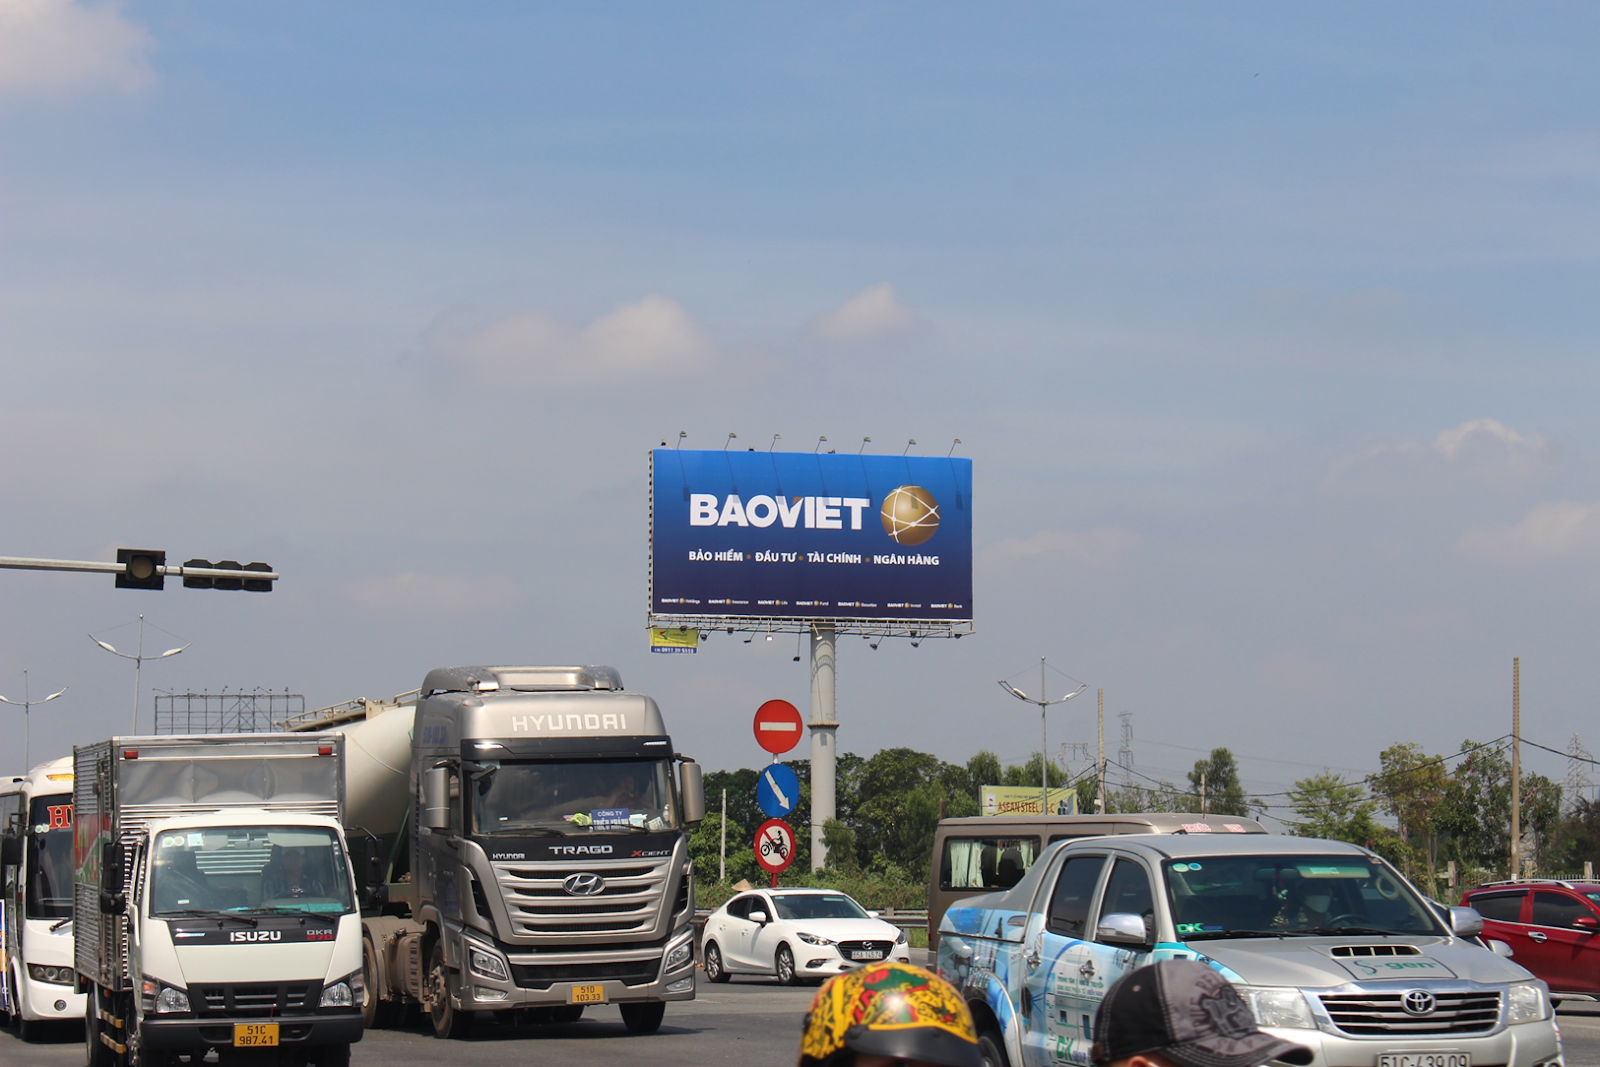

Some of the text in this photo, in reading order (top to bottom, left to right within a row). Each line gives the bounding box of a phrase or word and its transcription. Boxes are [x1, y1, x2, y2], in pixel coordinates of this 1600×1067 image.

[690, 494, 870, 530] BAOVIET
[689, 548, 940, 565] BẢO HIỂM ĐẦU TƯ TÀI CHÍNH NGÂN HÀNG
[511, 714, 626, 731] HYUNDAI
[998, 801, 1020, 813] ASEAN
[1021, 802, 1039, 813] STEEL
[47, 798, 74, 829] H
[548, 845, 613, 855] TRAGO
[230, 931, 281, 942] ISUZU
[576, 993, 601, 1002] 103.33
[247, 1025, 266, 1035] 51C
[239, 1035, 273, 1045] 987.41
